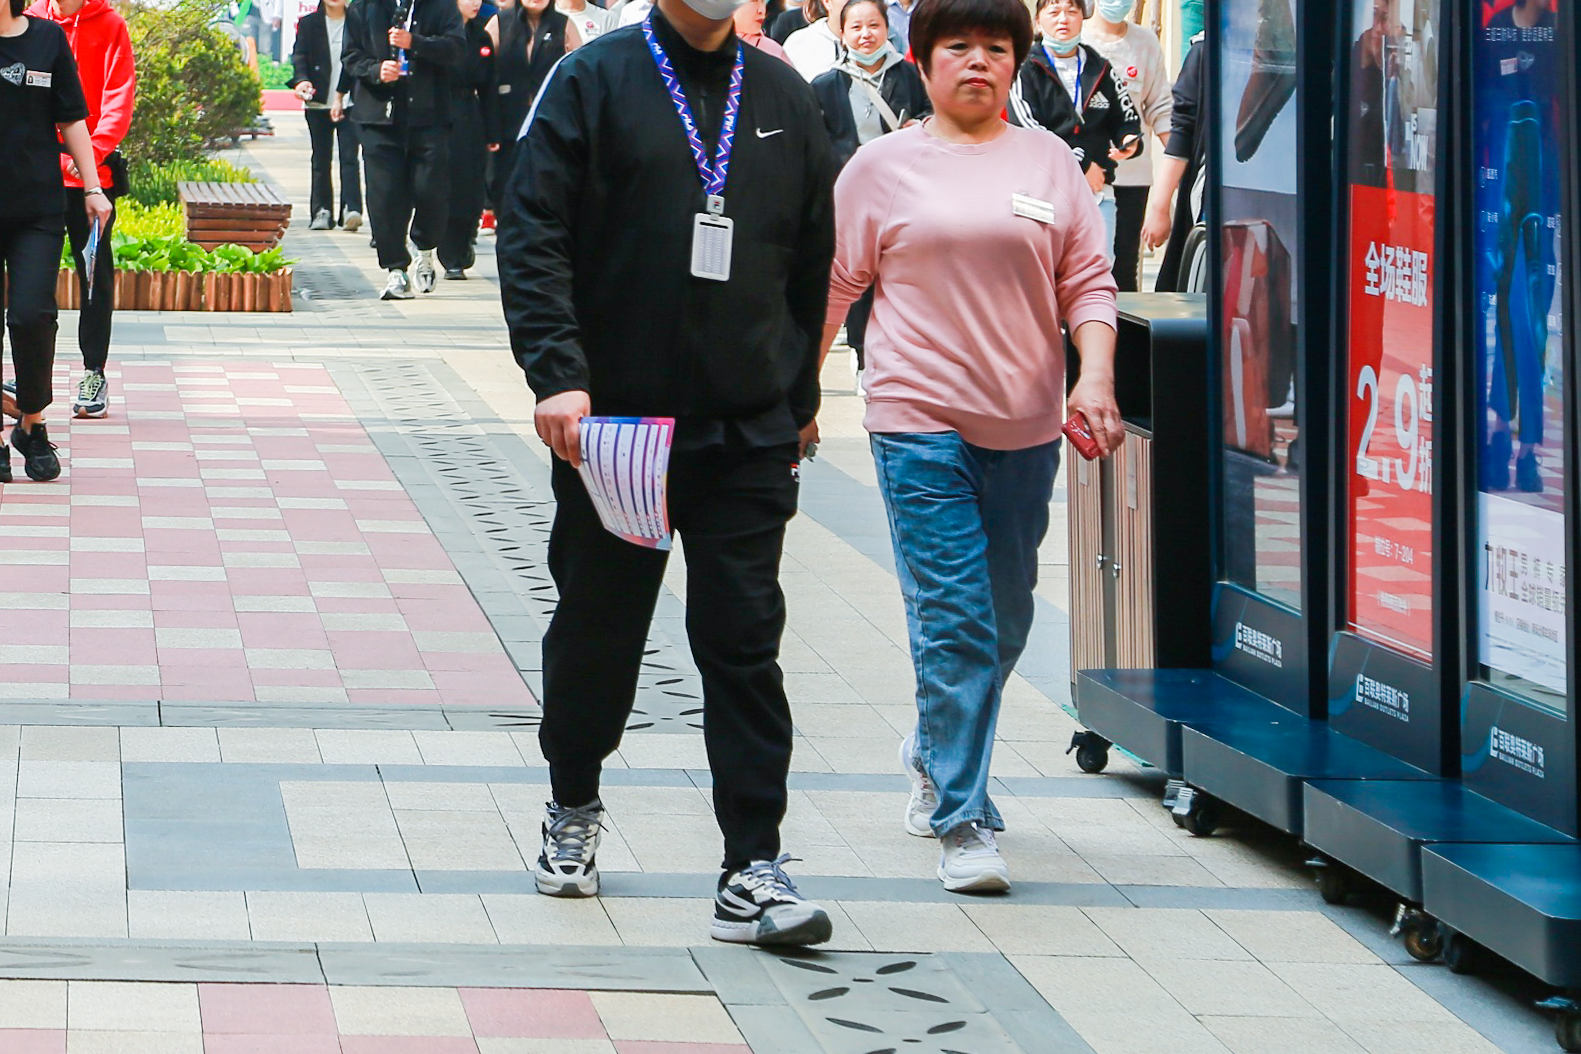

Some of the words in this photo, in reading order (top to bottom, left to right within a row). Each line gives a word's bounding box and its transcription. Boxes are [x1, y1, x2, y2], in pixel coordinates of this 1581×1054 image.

[1364, 241, 1428, 307] 全场鞋服
[1356, 364, 1419, 490] 2.9
